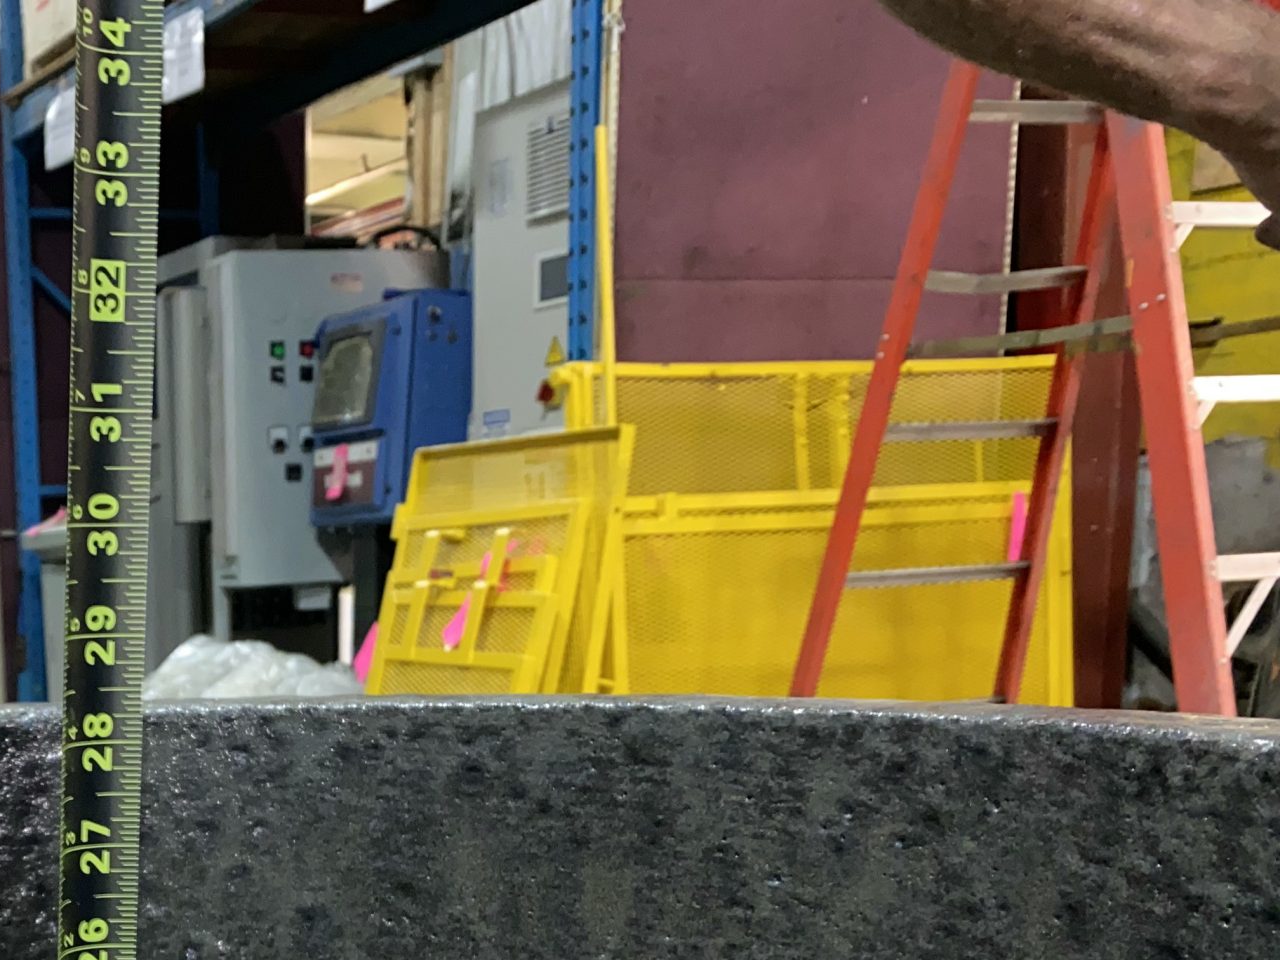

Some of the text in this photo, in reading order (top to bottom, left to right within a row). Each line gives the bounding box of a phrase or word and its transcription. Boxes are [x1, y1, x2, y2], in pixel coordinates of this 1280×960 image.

[98, 17, 131, 86] 34
[95, 140, 129, 207] 33
[93, 264, 121, 315] 32
[75, 388, 86, 403] 7
[90, 383, 122, 443] 31
[87, 493, 120, 557] 30
[84, 605, 117, 666] 29
[68, 726, 78, 740] 4
[81, 712, 114, 772] 28
[65, 831, 76, 846] 3
[79, 819, 111, 875] 27
[63, 933, 75, 947] 2
